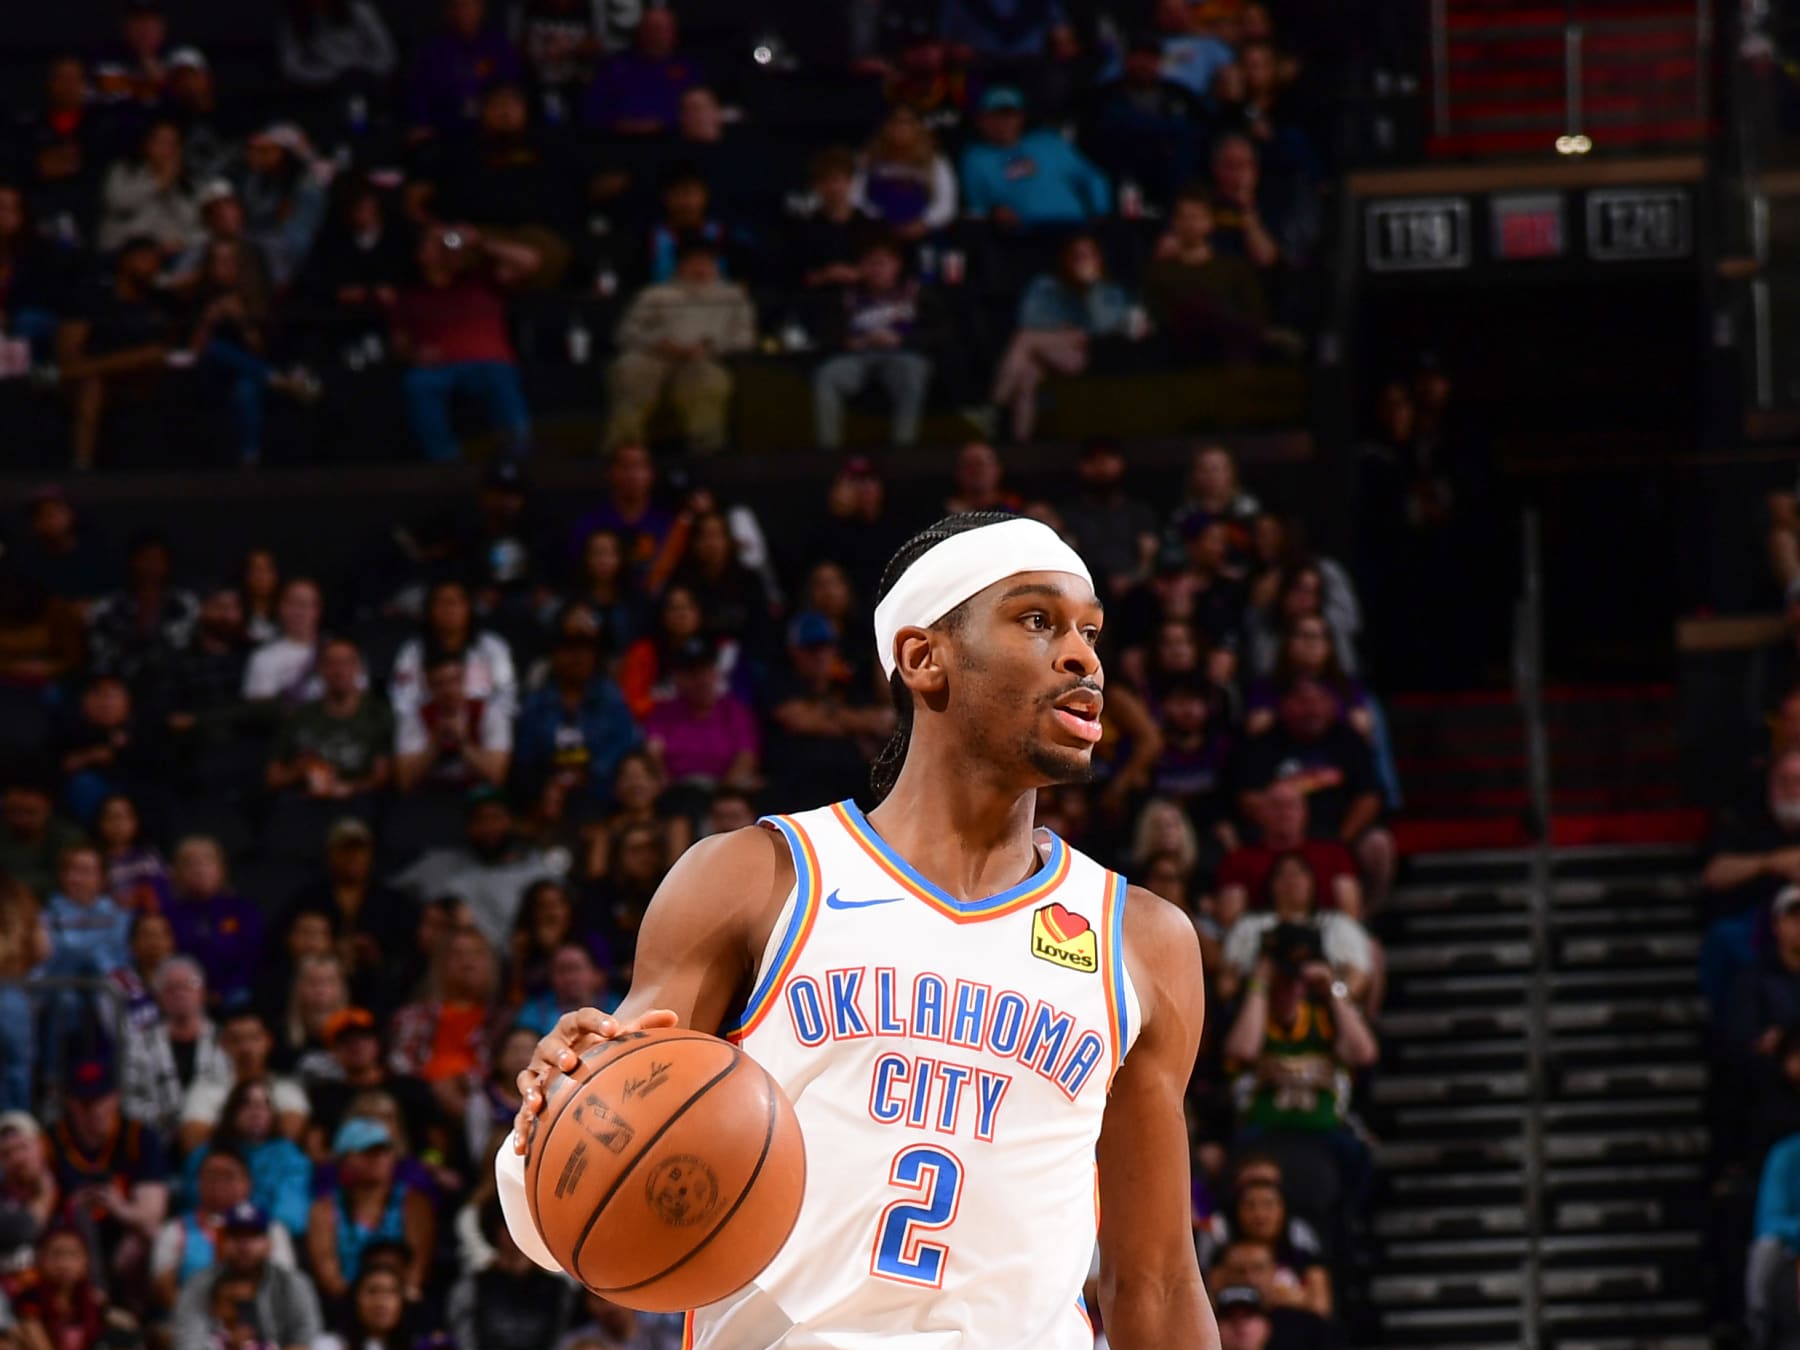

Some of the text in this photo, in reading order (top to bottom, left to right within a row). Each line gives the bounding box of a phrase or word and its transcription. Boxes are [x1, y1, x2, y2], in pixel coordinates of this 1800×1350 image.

[785, 967, 1104, 1102] OKLAHOMA
[868, 1052, 1013, 1142] CITY
[869, 1142, 965, 1290] 2
